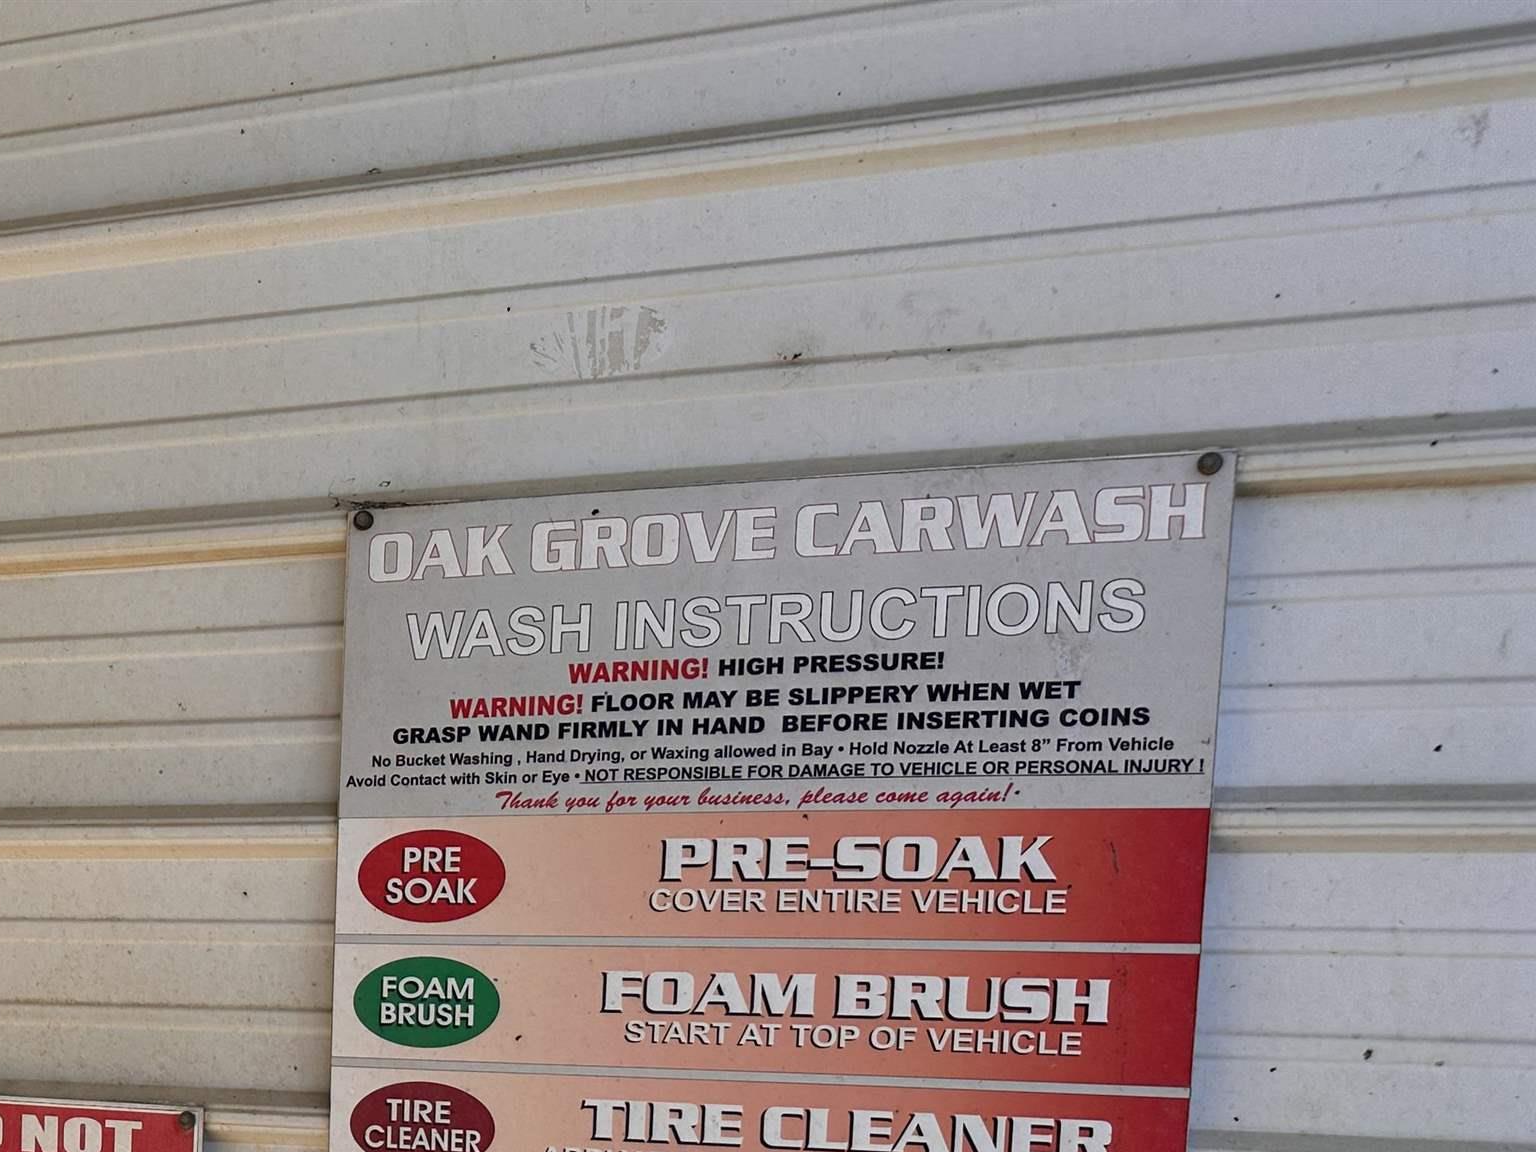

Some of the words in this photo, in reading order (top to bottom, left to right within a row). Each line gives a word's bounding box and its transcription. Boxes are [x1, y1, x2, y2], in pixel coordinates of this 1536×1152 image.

[368, 523, 515, 583] OAK
[531, 507, 776, 573] GROVE
[795, 482, 1210, 557] CARWASH
[406, 603, 592, 660] WASH
[614, 578, 1145, 650] INSTRUCTIONS
[568, 658, 708, 684] WARNING!
[719, 657, 784, 677] HIGH
[793, 651, 944, 674] PRESSURE!
[449, 694, 583, 719] WARNING!
[591, 693, 674, 713] FLOOR
[683, 690, 738, 709] MAY
[746, 689, 780, 707] BE
[788, 684, 919, 706] SLIPPERY
[926, 682, 1010, 702] WHEN
[1018, 680, 1081, 700] WET
[393, 726, 471, 745] GRASP
[478, 723, 550, 742] WAND
[557, 719, 650, 740] FIRMLY
[656, 718, 683, 737] IN
[692, 716, 765, 736] HAND
[781, 713, 888, 733] BEFORE
[897, 709, 1050, 730] INSERTING
[1059, 707, 1150, 727] COINS
[371, 755, 391, 768] No
[395, 752, 446, 767] Bucket
[526, 750, 565, 764] Hand
[570, 748, 625, 765] Drying,
[630, 750, 647, 760] or
[651, 746, 709, 762] Waxing
[714, 744, 776, 759] allowed
[801, 743, 833, 759] Bay
[849, 741, 888, 756] Hold
[893, 741, 949, 755] Nozzle
[954, 740, 973, 753] At
[978, 739, 1026, 753] Least
[1056, 738, 1103, 752] From
[1109, 737, 1175, 752] Vehicle
[346, 774, 386, 788] Avoid
[390, 773, 446, 787] Contact
[450, 772, 480, 785] with
[484, 771, 517, 785] Skin
[522, 773, 538, 784] or
[542, 770, 571, 786] Eye
[585, 768, 620, 782] NOT
[623, 765, 743, 781] RESPONSIBLE
[747, 765, 784, 778] FOR
[788, 763, 865, 777] DAMAGE
[870, 762, 894, 776] TO
[899, 761, 977, 776] VEHICLE
[982, 761, 1010, 775] OR
[1015, 759, 1119, 774] PERSONAL
[495, 790, 560, 810] Thank
[565, 796, 601, 813] you
[605, 790, 640, 812] for
[643, 794, 695, 811] your
[697, 786, 790, 806] business,
[797, 786, 869, 809] please
[875, 790, 929, 804] come
[935, 782, 1014, 808] again!
[403, 846, 461, 874] PRE
[660, 834, 1057, 883] PRE-SOAK
[385, 877, 478, 905] SOAK
[648, 888, 766, 913] COVER
[777, 888, 902, 913] ENTIRE
[910, 889, 1068, 915] VEHICLE
[381, 976, 475, 1001] FOAM
[600, 969, 817, 1017] FOAM
[832, 975, 1110, 1024] BRUSH
[379, 1003, 475, 1028] BRUSH
[623, 1021, 731, 1046] START
[737, 1023, 782, 1047] AT
[789, 1024, 860, 1050] TOP
[869, 1026, 918, 1051] OF
[925, 1028, 1083, 1056] VEHICLE
[386, 1098, 451, 1125] TIRE
[580, 1098, 744, 1147] TIRE
